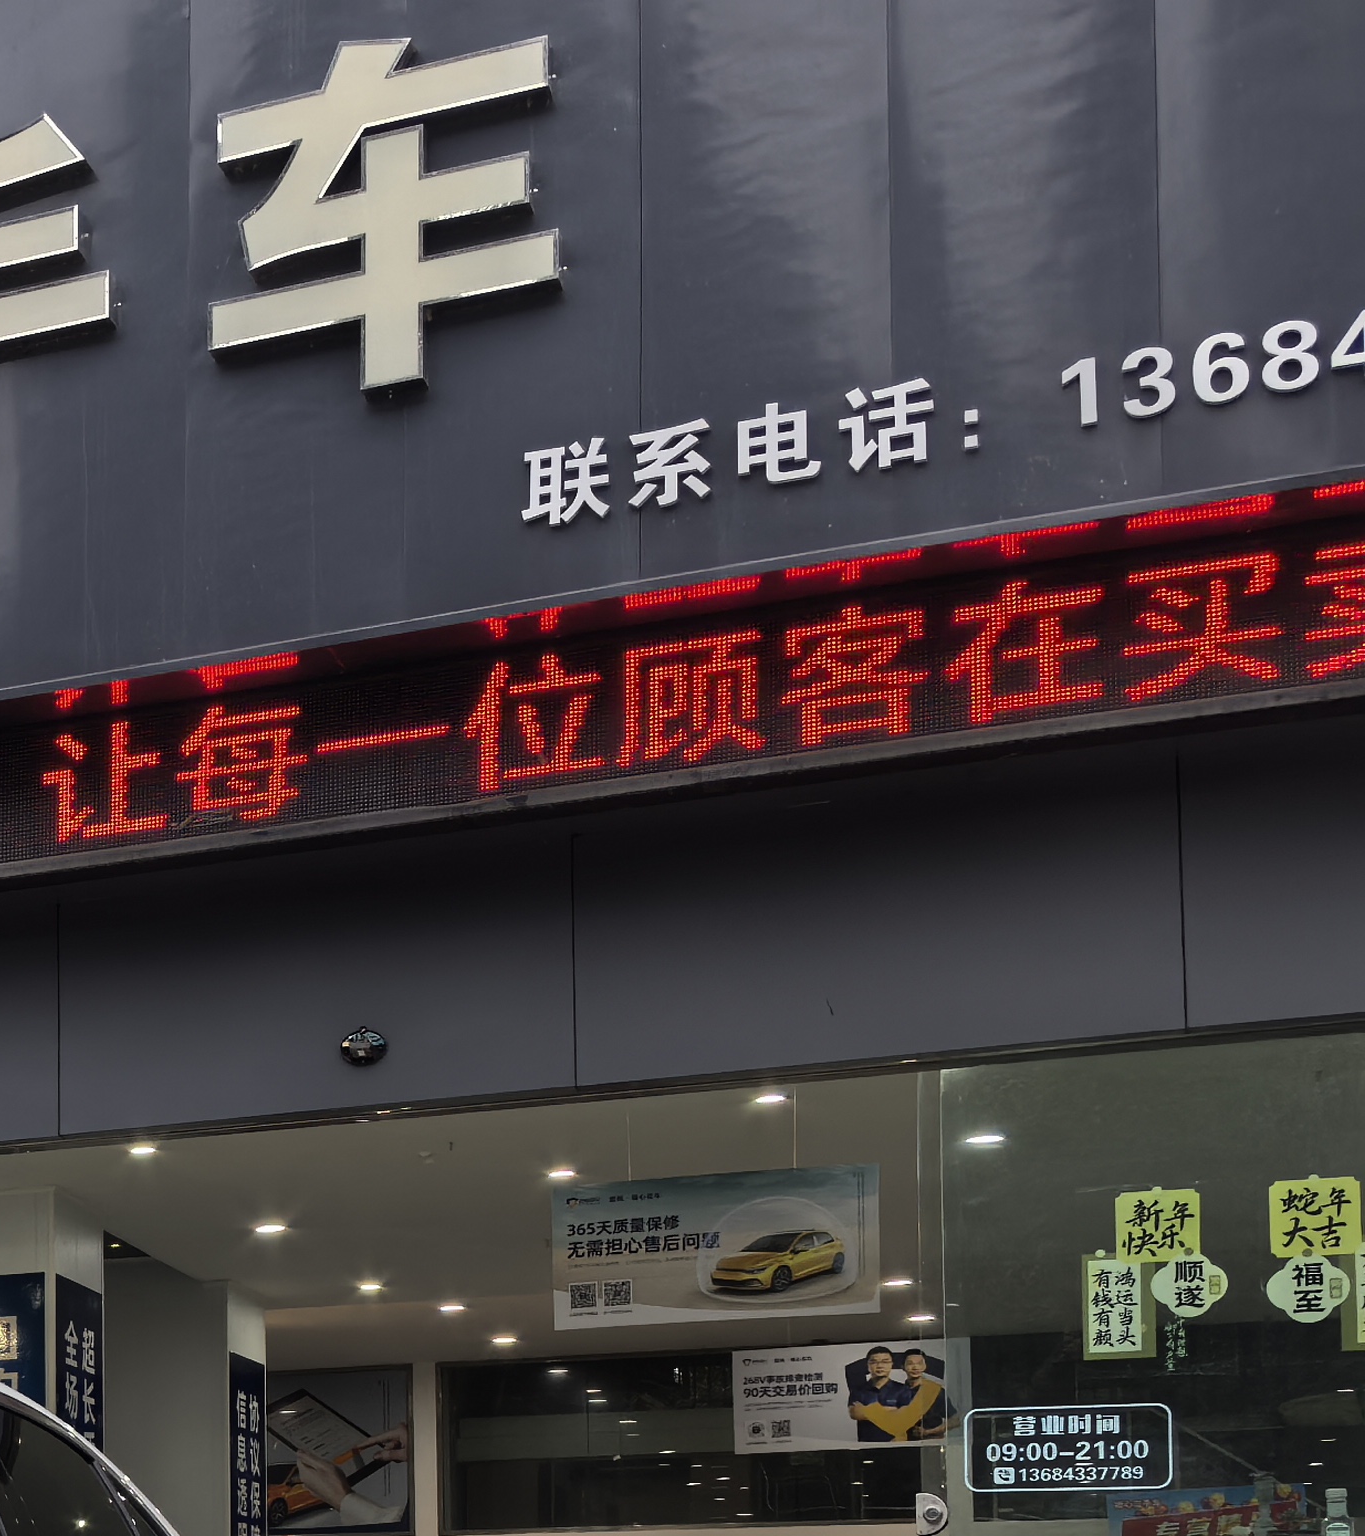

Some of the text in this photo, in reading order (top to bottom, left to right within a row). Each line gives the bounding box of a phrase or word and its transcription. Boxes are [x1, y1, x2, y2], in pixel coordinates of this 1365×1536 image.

[1125, 1199, 1195, 1232] 新年
[1280, 1186, 1352, 1217] 蛇年
[566, 1215, 680, 1237] 365天质量保修
[1122, 1226, 1185, 1257] 快乐
[1282, 1216, 1347, 1249] 大吉
[567, 1231, 721, 1259] 无需担心售后问题
[1174, 1260, 1206, 1309] 顺遂
[1292, 1262, 1325, 1314] 福至
[1012, 1414, 1121, 1436] 营业时间
[1018, 1465, 1144, 1483] 13684337789
